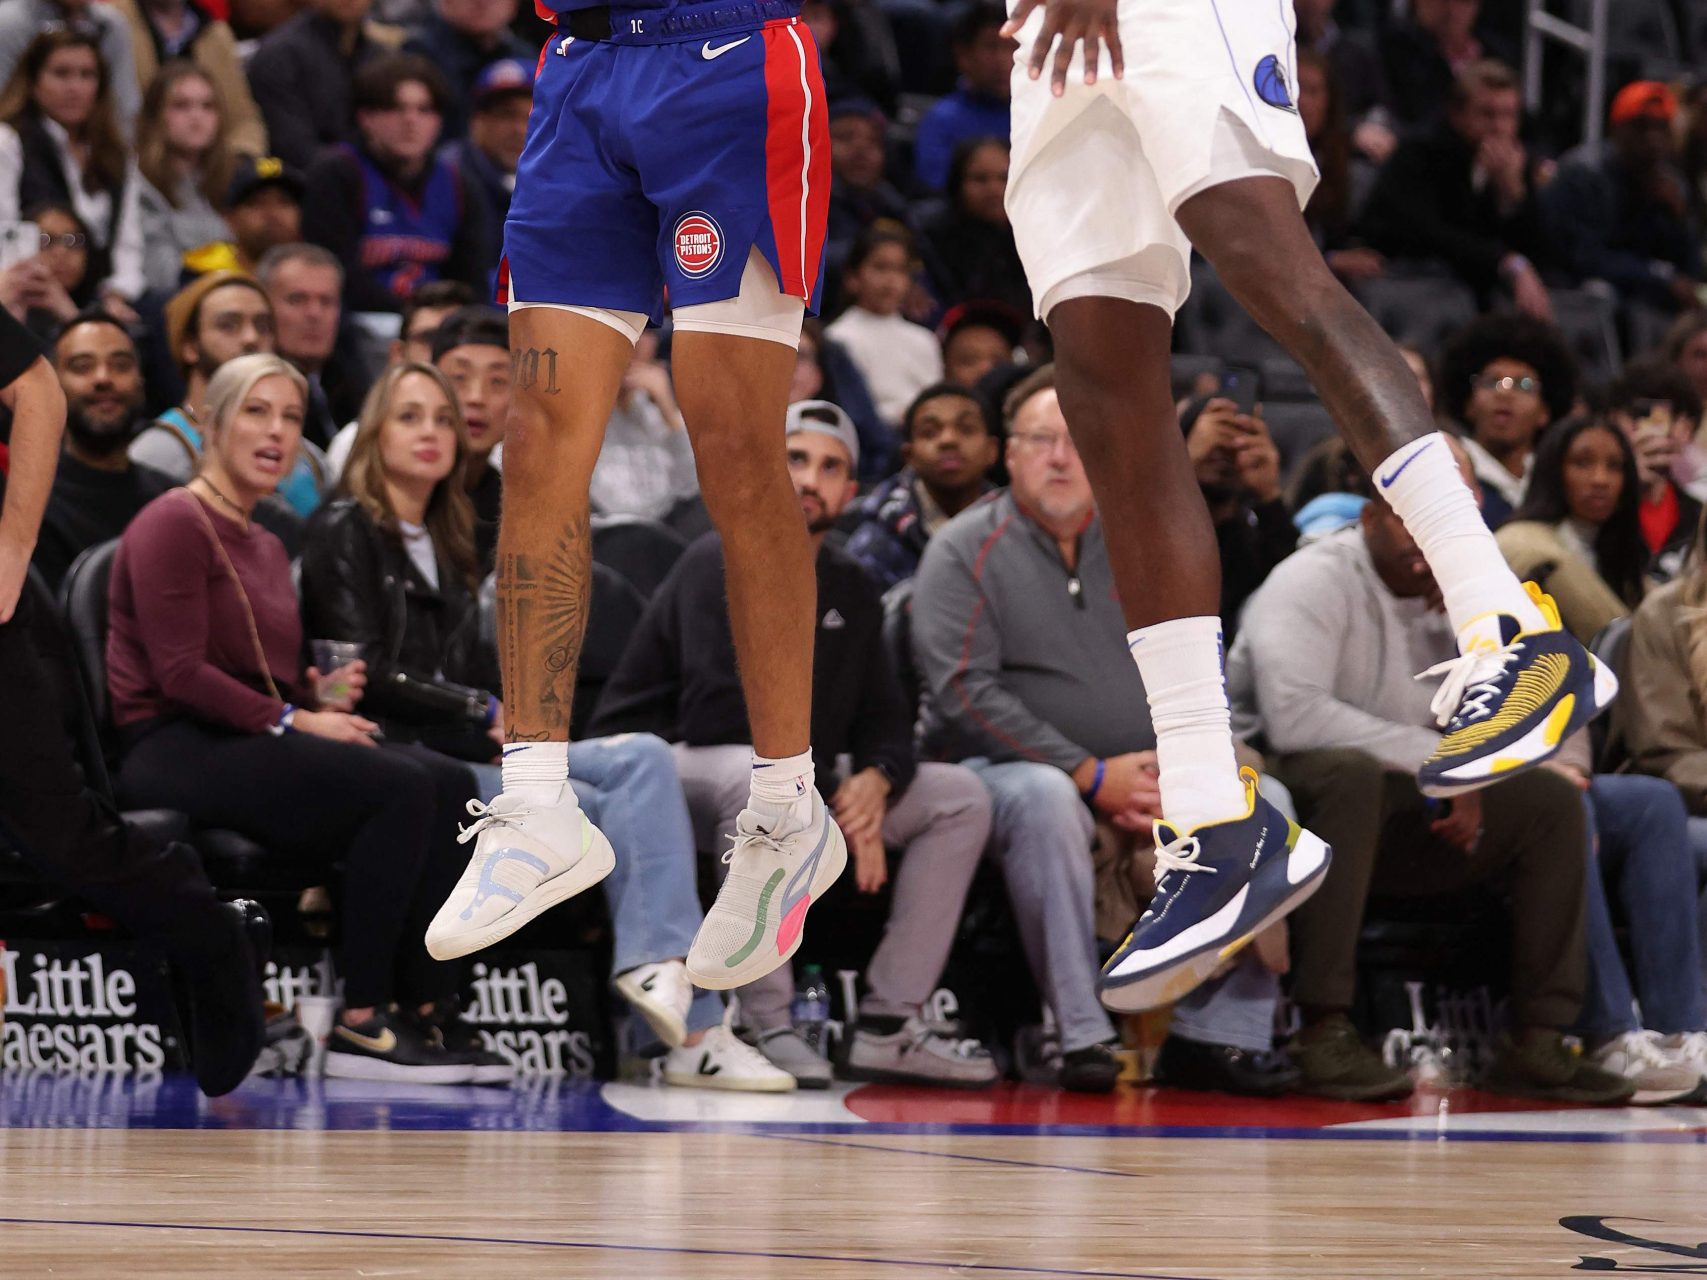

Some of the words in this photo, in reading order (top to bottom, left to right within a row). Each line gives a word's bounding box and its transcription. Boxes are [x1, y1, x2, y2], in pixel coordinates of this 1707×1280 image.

[679, 232, 712, 245] DETROIT
[680, 243, 713, 256] PISTONS
[3, 950, 137, 1017] Little
[2, 1020, 166, 1071] aesars
[478, 1029, 596, 1077] sars
